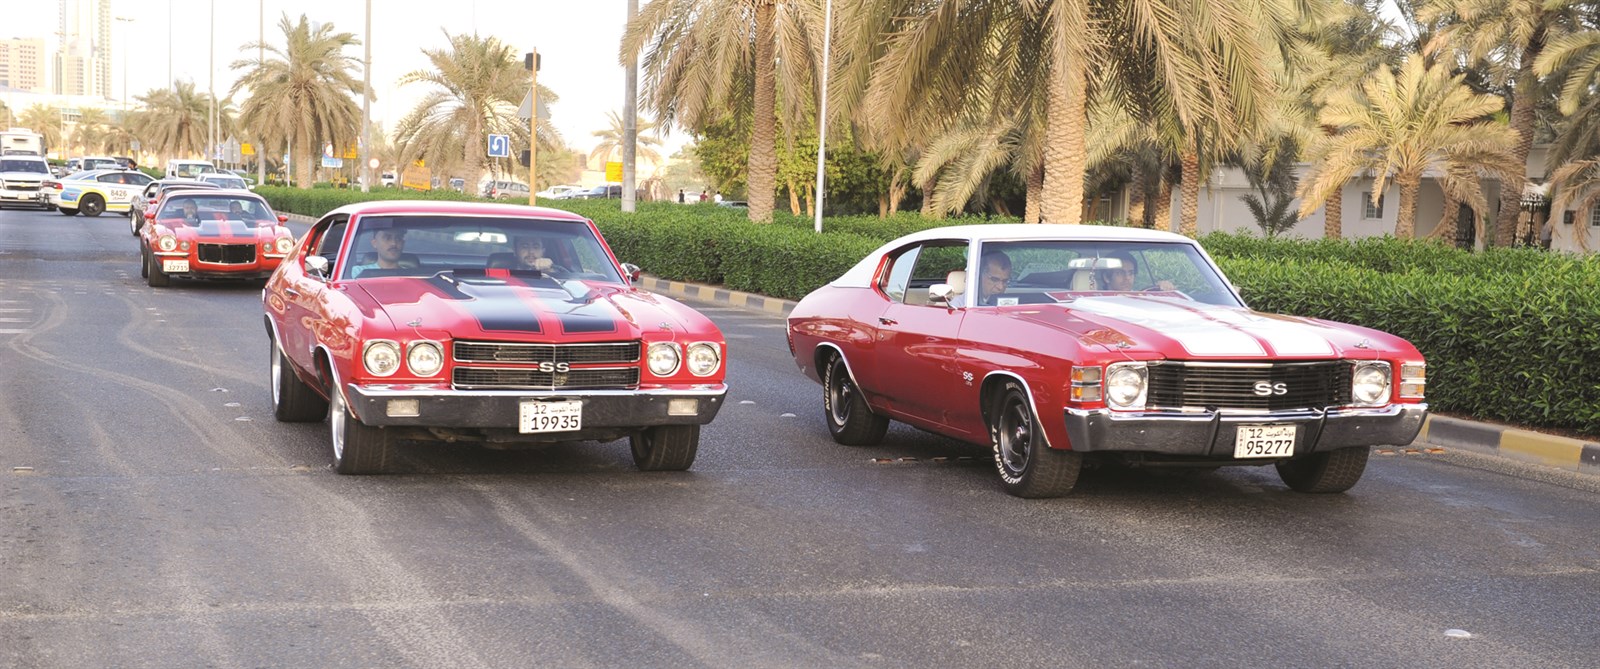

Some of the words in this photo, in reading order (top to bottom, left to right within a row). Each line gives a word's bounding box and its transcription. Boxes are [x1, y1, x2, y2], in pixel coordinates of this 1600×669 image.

[539, 362, 570, 372] SS
[962, 371, 974, 381] SS
[1254, 382, 1288, 396] SS
[534, 404, 547, 414] 12
[531, 415, 579, 430] 19935
[1249, 429, 1263, 438] 12
[1246, 440, 1293, 455] 95277
